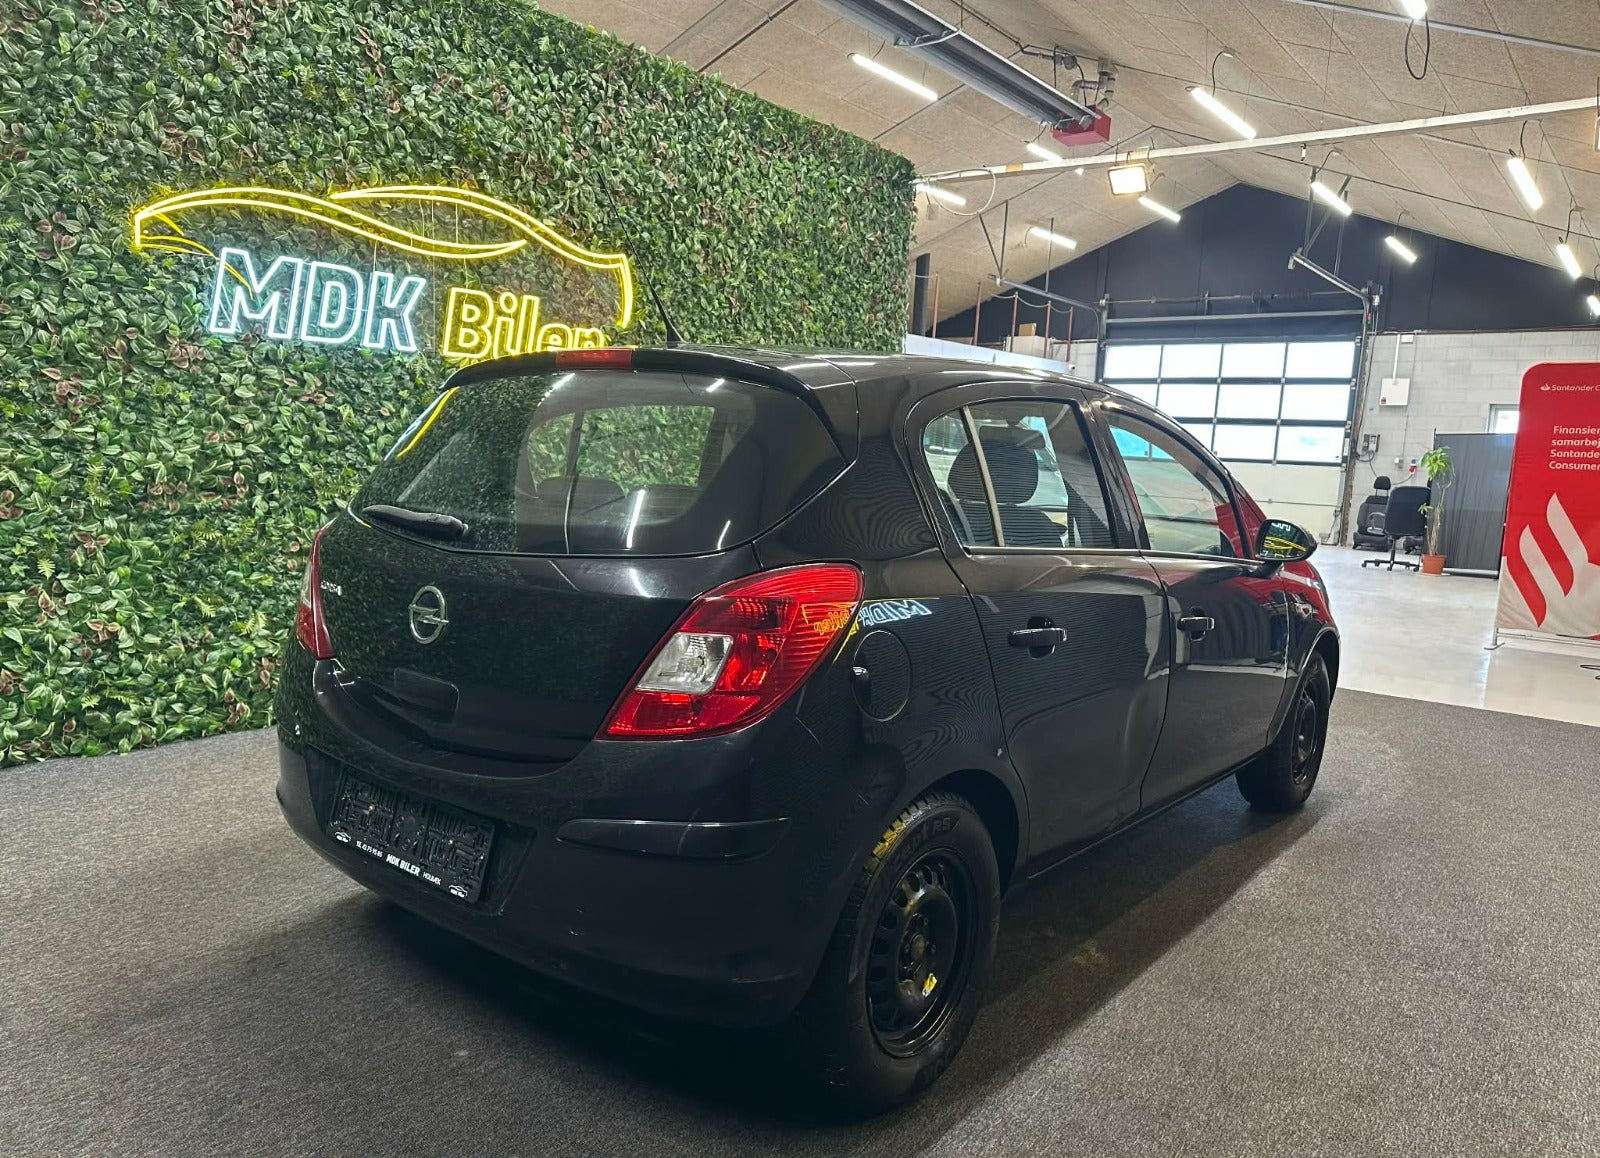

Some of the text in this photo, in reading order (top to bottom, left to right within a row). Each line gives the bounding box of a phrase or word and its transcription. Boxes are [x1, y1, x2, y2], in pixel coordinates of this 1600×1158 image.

[208, 246, 426, 353] MDK
[1551, 384, 1594, 392] Santander
[1549, 449, 1600, 459] Santande
[400, 860, 421, 876] BILER
